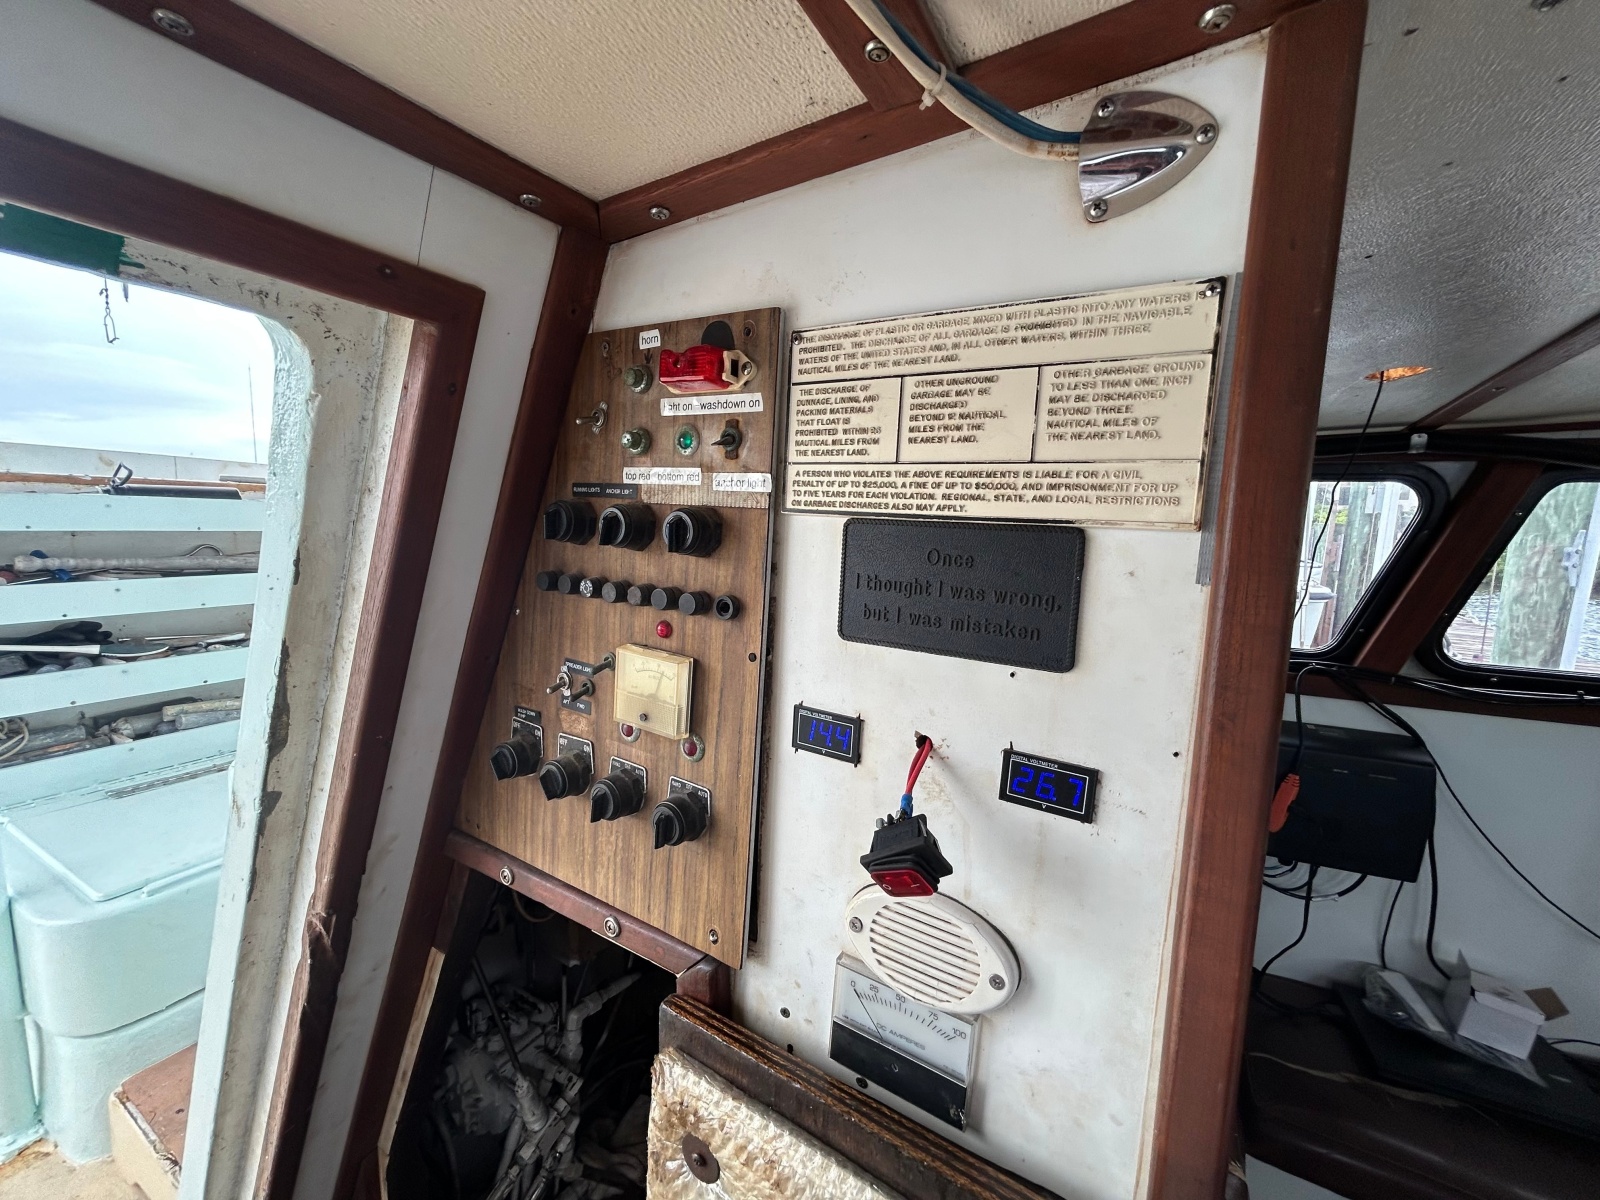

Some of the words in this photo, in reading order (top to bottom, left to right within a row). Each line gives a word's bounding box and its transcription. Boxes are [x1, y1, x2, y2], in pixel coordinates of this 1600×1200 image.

[642, 335, 658, 345] horn
[798, 365, 833, 376] NAUTICAL
[835, 364, 858, 372] MILES
[873, 360, 889, 369] THE
[892, 357, 933, 367] NEAREST
[934, 354, 960, 363] LAND.
[1054, 370, 1090, 379] OTHER
[1094, 364, 1149, 377] GARBAGE
[1153, 361, 1205, 372] GROUND
[914, 380, 944, 388] OTHER
[946, 375, 999, 386] UNGROUND
[1050, 383, 1065, 392] TO
[1067, 381, 1096, 391] LESS
[1101, 379, 1130, 389] THAN
[1134, 376, 1160, 387] ONE
[1162, 375, 1192, 386] INCH
[815, 385, 857, 395] DISCHARGE
[860, 384, 871, 392] OF
[910, 390, 953, 400] GARBAGE
[955, 389, 975, 397] MAY
[978, 387, 991, 396] BE
[797, 398, 833, 407] DUNNAGE,
[863, 394, 879, 402] AND
[1049, 394, 1073, 405] MAY
[1074, 393, 1089, 403] BE
[1092, 390, 1167, 402] DISCHARGED
[749, 400, 760, 408] on
[910, 401, 968, 411] DISCHARGED
[829, 406, 874, 415] MATERIALS
[909, 413, 945, 422] BEYOND
[958, 410, 1006, 420] NAUTICAL
[1047, 406, 1091, 416] BEYOND
[1095, 405, 1134, 414] THREE
[817, 418, 841, 426] FLOAT
[842, 417, 851, 425] IS
[1046, 418, 1100, 430] NAUTICAL
[1102, 417, 1138, 427] MILES
[1142, 416, 1160, 426] OF
[795, 428, 838, 436] PROHIBITED
[842, 427, 868, 435] WITHIN
[908, 425, 935, 433] MILES
[938, 424, 964, 432] FROM
[966, 423, 985, 431] THE
[908, 435, 949, 444] NEAREST
[951, 435, 978, 443] LAND.
[1046, 432, 1068, 441] THE
[1070, 430, 1123, 441] NEAREST
[1126, 430, 1162, 440] LAND.
[626, 472, 636, 481] top
[639, 471, 650, 480] red
[658, 472, 683, 481] bottom
[687, 473, 699, 481] red
[853, 470, 891, 478] VIOLATES
[912, 470, 942, 478] ABOVE
[945, 470, 1019, 478] REQUIREMENTS
[1023, 470, 1032, 478] IS
[1035, 470, 1072, 479] LIABLE
[1076, 470, 1098, 479] FOR
[1100, 471, 1109, 479] A
[1112, 470, 1142, 479] CIVIL
[1046, 483, 1131, 492] IMPRISONMENT
[1132, 483, 1157, 492] FOR
[1160, 483, 1178, 492] UP
[890, 492, 937, 500] VIOLATION.
[942, 493, 990, 502] REGIONAL,
[994, 495, 1029, 503] STATE,
[1055, 495, 1090, 504] LOCAL
[1096, 496, 1180, 506] RESTRICTIONS
[804, 500, 837, 508] GARBAGE
[936, 504, 967, 512] APPLY.
[927, 548, 973, 568] Once
[867, 573, 931, 598] thought
[950, 584, 985, 602] was
[994, 589, 1062, 614] wrong,
[863, 603, 890, 622] but
[910, 611, 941, 628] was
[951, 615, 1041, 642] mistaken
[809, 720, 850, 750] 14.4
[1011, 754, 1028, 762] DIGITAL
[1030, 759, 1058, 768] VOLTMETER
[1012, 767, 1083, 806] 26.7
[870, 984, 879, 993] 25
[895, 993, 905, 1003] 50
[928, 1010, 938, 1021] 75
[876, 1022, 887, 1032] DC
[890, 1029, 925, 1050] AMPERES
[952, 1027, 966, 1040] 100
